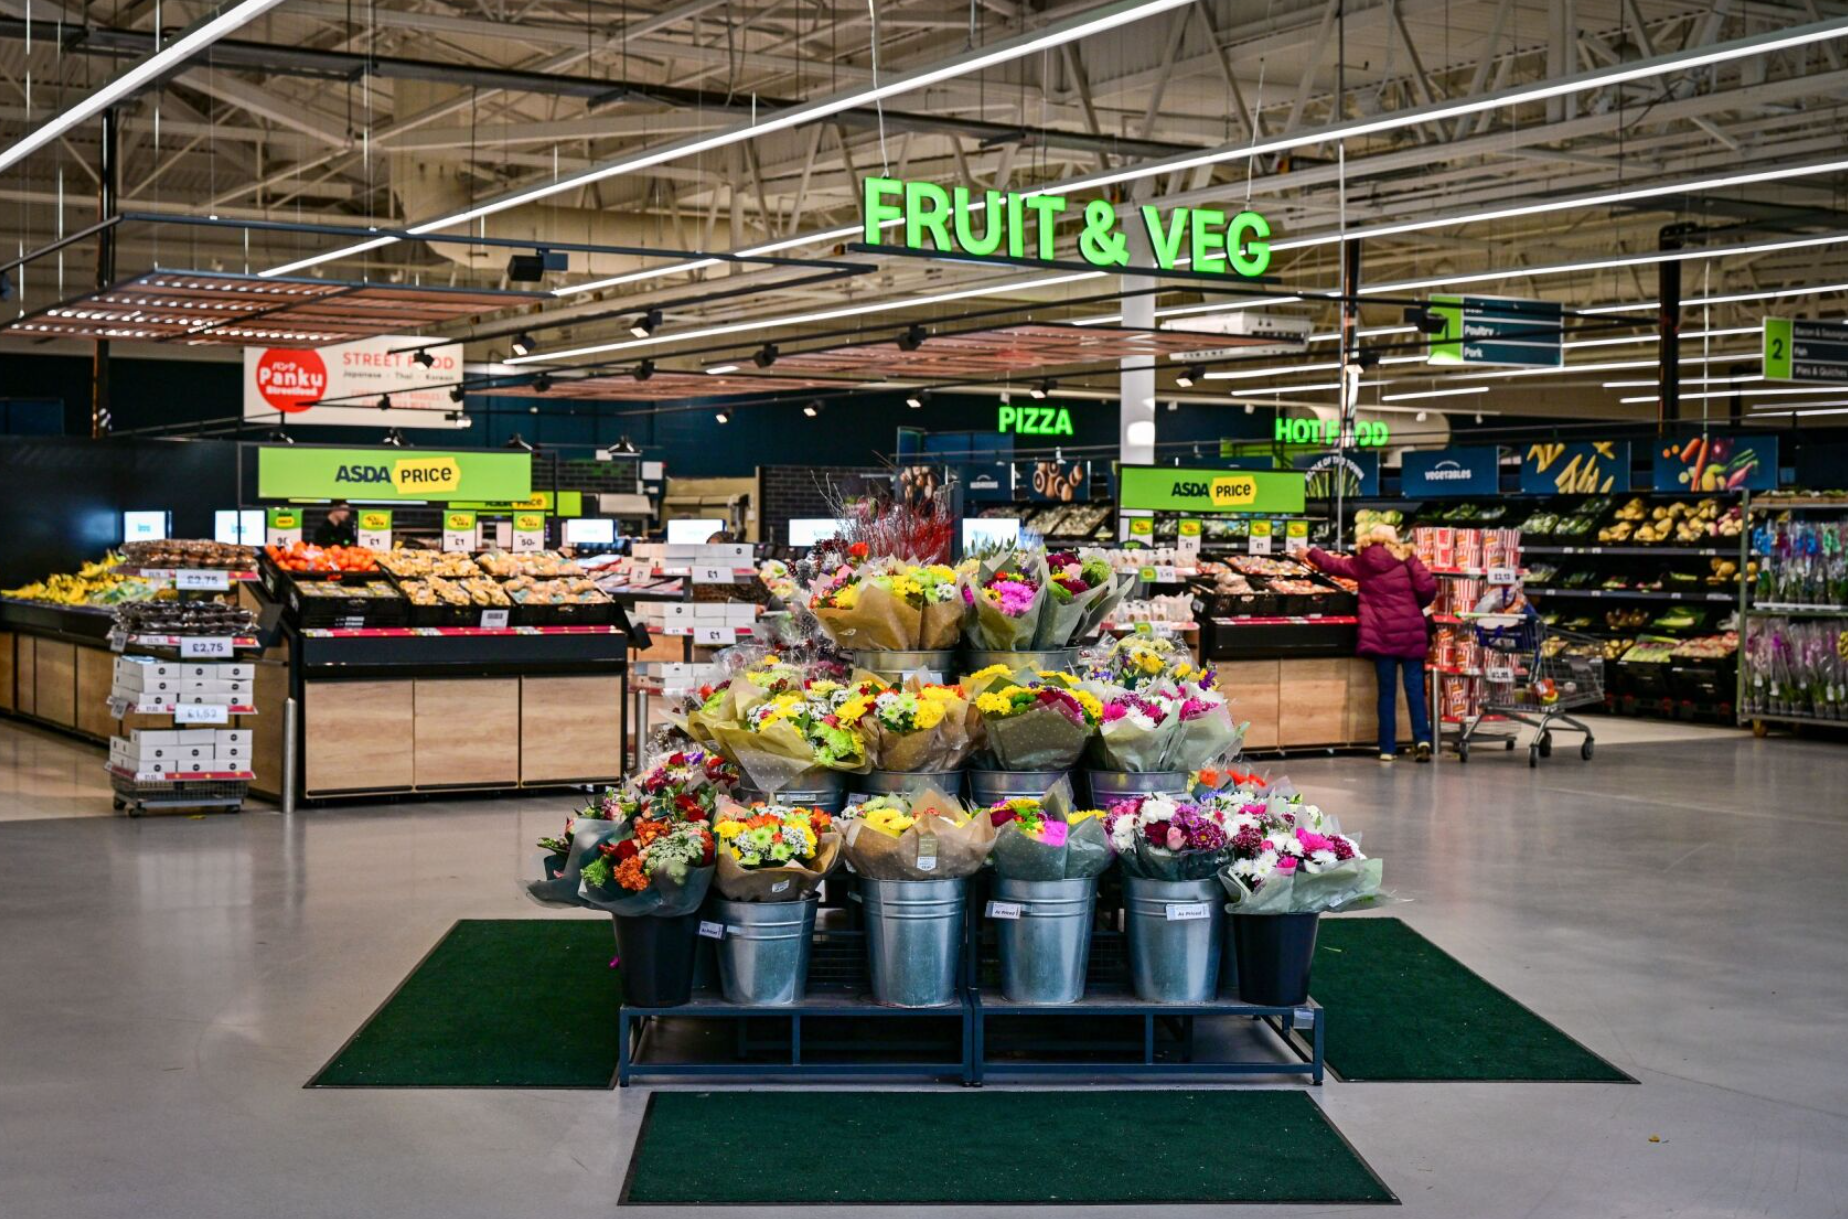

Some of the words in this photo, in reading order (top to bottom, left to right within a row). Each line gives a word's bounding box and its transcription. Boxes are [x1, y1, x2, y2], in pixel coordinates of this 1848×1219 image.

[863, 176, 1066, 261] FRUIT
[1078, 199, 1130, 267] &
[1140, 204, 1271, 277] VEG
[1464, 347, 1483, 358] Pork
[1772, 338, 1784, 360] 2
[343, 353, 402, 367] STREET
[259, 366, 323, 387] Panku
[998, 406, 1074, 435] PIZZA
[1275, 417, 1321, 443] HOT
[1325, 420, 1390, 446] FOD
[335, 465, 391, 483] ASDA
[1171, 481, 1210, 497] ASDA
[707, 570, 718, 579] £1
[709, 631, 720, 640] £1
[192, 642, 224, 653] £2.75
